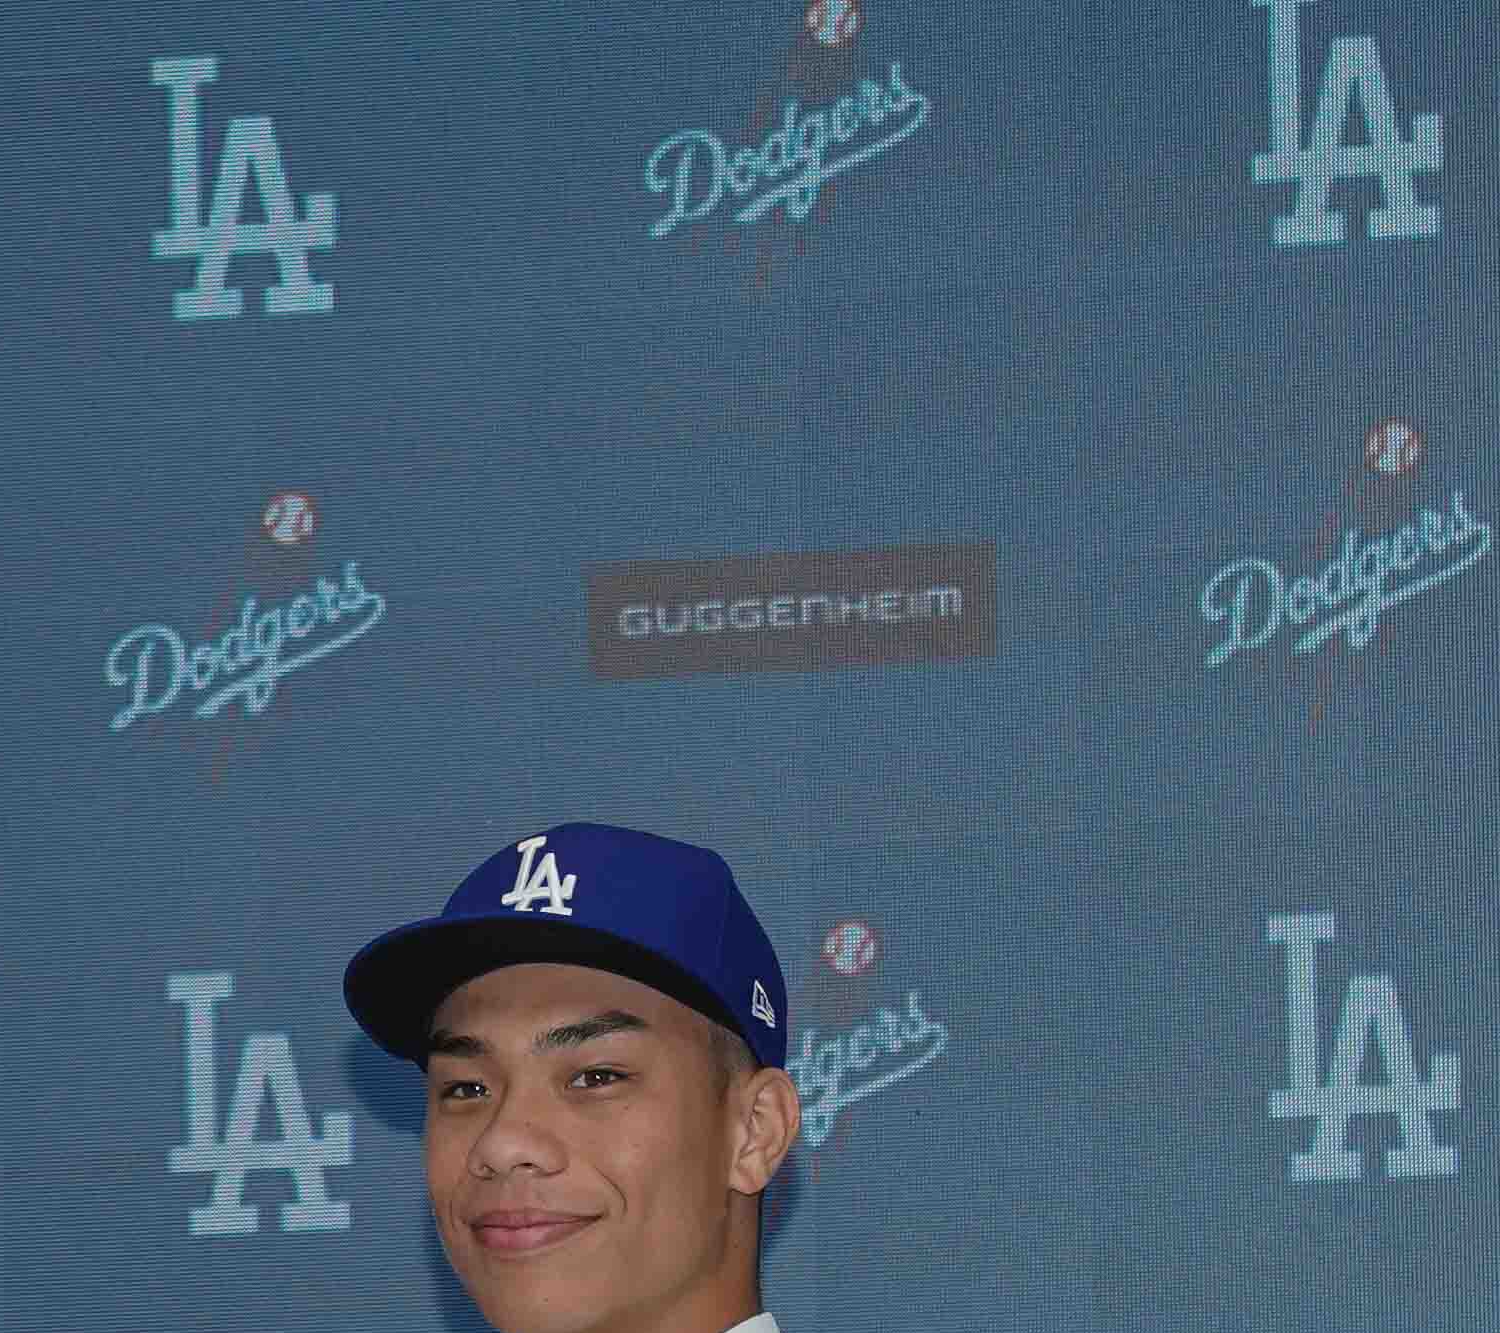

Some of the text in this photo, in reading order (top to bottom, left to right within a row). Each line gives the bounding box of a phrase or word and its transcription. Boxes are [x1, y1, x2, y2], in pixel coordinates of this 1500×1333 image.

[150, 57, 340, 321] LA
[644, 62, 930, 239] Dodgers
[1251, 0, 1444, 247] LA
[106, 560, 386, 732] Dodgers
[617, 587, 963, 641] GUGGENHEIM
[1200, 491, 1491, 669] Dodgers
[501, 836, 578, 916] LA
[167, 972, 353, 1236] LA
[786, 992, 949, 1146] dgers
[1267, 913, 1461, 1182] LA
